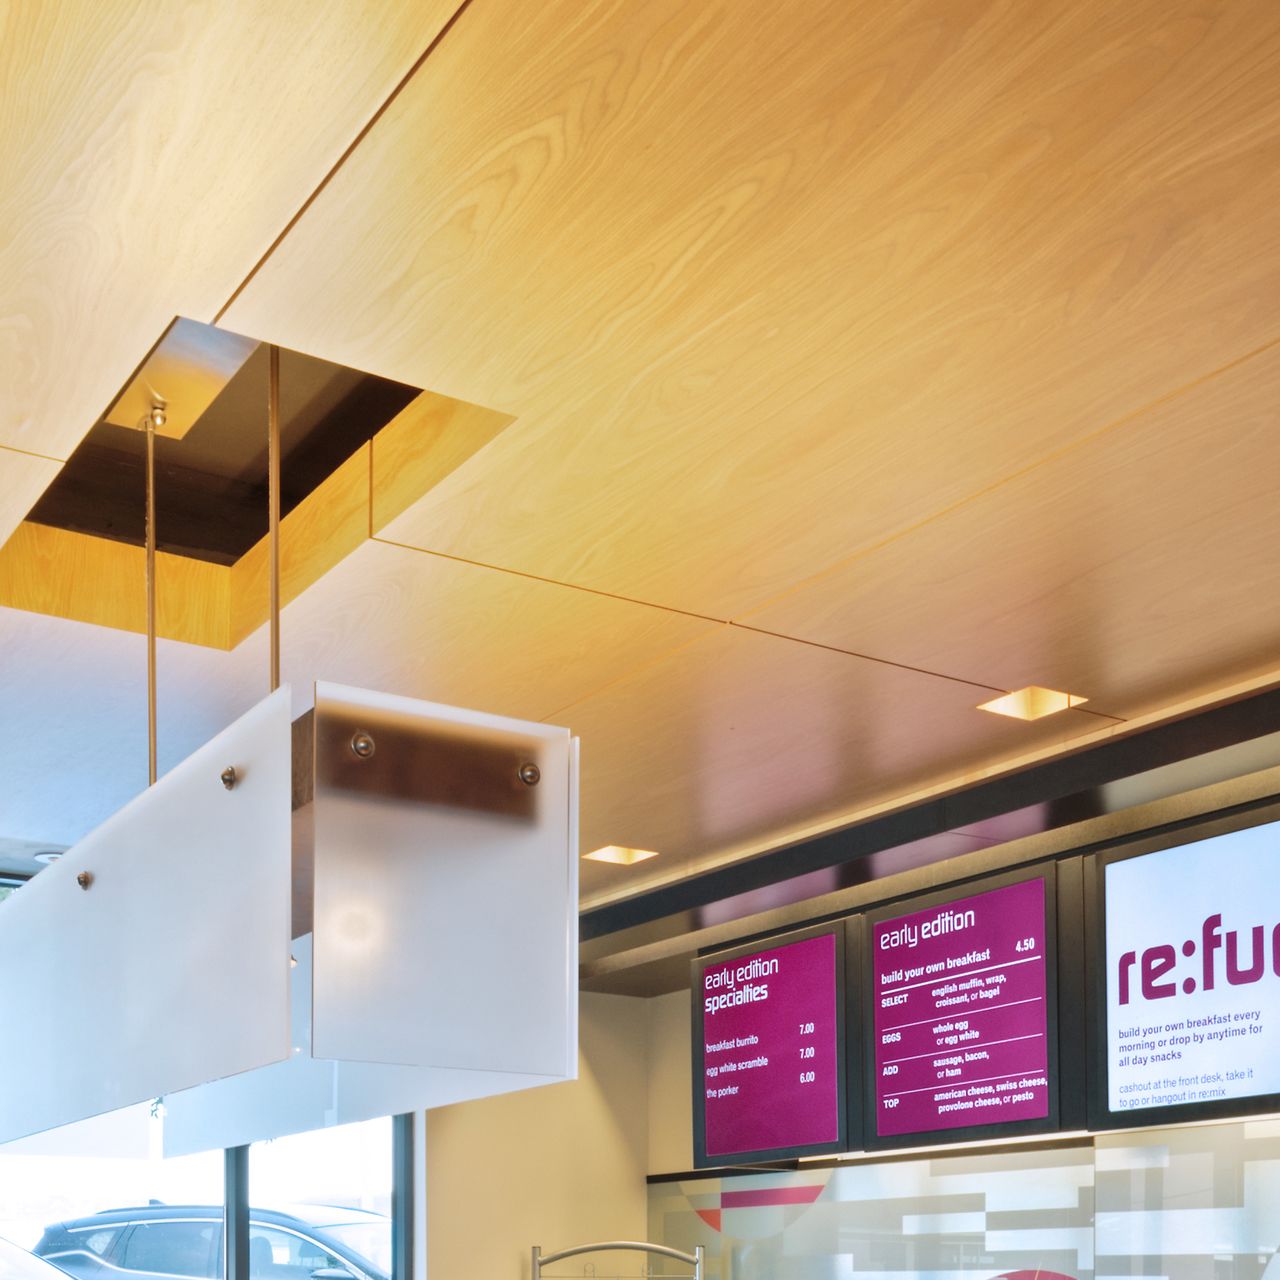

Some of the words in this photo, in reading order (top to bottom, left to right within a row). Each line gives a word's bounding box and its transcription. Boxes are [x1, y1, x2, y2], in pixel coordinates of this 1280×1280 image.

[880, 923, 919, 950] early
[921, 910, 975, 939] edition
[881, 969, 903, 985] build
[904, 966, 925, 982] your
[925, 961, 946, 974] own
[946, 948, 991, 969] breakfast
[1015, 937, 1036, 953] 4.50
[705, 967, 736, 989] early
[736, 958, 779, 983] edition
[931, 983, 958, 997] english
[958, 977, 985, 991] muffin,
[985, 974, 1007, 985] wrap,
[935, 993, 970, 1008] croissant,
[970, 992, 979, 1001] or
[979, 985, 1000, 999] bagel
[705, 983, 769, 1015] specialties
[881, 993, 909, 1008] SELECT
[932, 1022, 955, 1034] whole
[954, 1020, 969, 1031] egg
[1118, 1026, 1140, 1039] build
[1142, 1025, 1163, 1038] your
[1165, 1022, 1184, 1032] own
[1186, 1013, 1231, 1029] breakfast
[1233, 1011, 1261, 1022] every
[705, 1038, 735, 1053] breakfast
[734, 1034, 759, 1048] burrito
[799, 1022, 815, 1035] 7.00
[881, 1032, 902, 1045] EGGS
[936, 1037, 944, 1046] or
[944, 1034, 958, 1045] egg
[958, 1029, 980, 1043] white
[1119, 1040, 1156, 1053] morning
[1157, 1039, 1167, 1047] or
[1169, 1035, 1191, 1046] drop
[1193, 1032, 1205, 1044] by
[1207, 1027, 1247, 1041] anytime
[1249, 1023, 1263, 1034] for
[706, 1066, 718, 1078] egg
[719, 1062, 738, 1074] white
[737, 1055, 769, 1071] scramble
[799, 1046, 815, 1059] 7.00
[933, 1055, 965, 1068] sausage,
[964, 1051, 990, 1062] bacon,
[1118, 1056, 1130, 1067] all
[1132, 1055, 1148, 1066] day
[1150, 1050, 1182, 1063] snacks
[882, 1065, 899, 1076] ADD
[936, 1071, 945, 1079] or
[945, 1068, 962, 1078] ham
[1119, 1080, 1152, 1094] cashout
[1152, 1080, 1162, 1090] at
[1163, 1078, 1177, 1089] the
[1178, 1075, 1199, 1086] front
[1200, 1072, 1224, 1084] desk,
[1225, 1069, 1246, 1081] take
[1247, 1068, 1254, 1079] it
[706, 1088, 717, 1099] the
[717, 1085, 739, 1099] porker
[799, 1071, 815, 1084] 6.00
[933, 1089, 967, 1102] american
[967, 1085, 995, 1096] cheese,
[995, 1080, 1018, 1092] swiss
[1018, 1077, 1048, 1089] cheese,
[883, 1098, 900, 1109] TOP
[938, 1100, 973, 1115] provolone
[973, 1096, 1003, 1108] cheese,
[1002, 1095, 1011, 1104] or
[1012, 1091, 1034, 1104] pesto
[1119, 1098, 1128, 1108] to
[1128, 1098, 1140, 1109] go
[1141, 1096, 1150, 1105] or
[1151, 1091, 1186, 1105] hangout
[1187, 1090, 1197, 1100] in
[1198, 1087, 1226, 1099] re:mix
